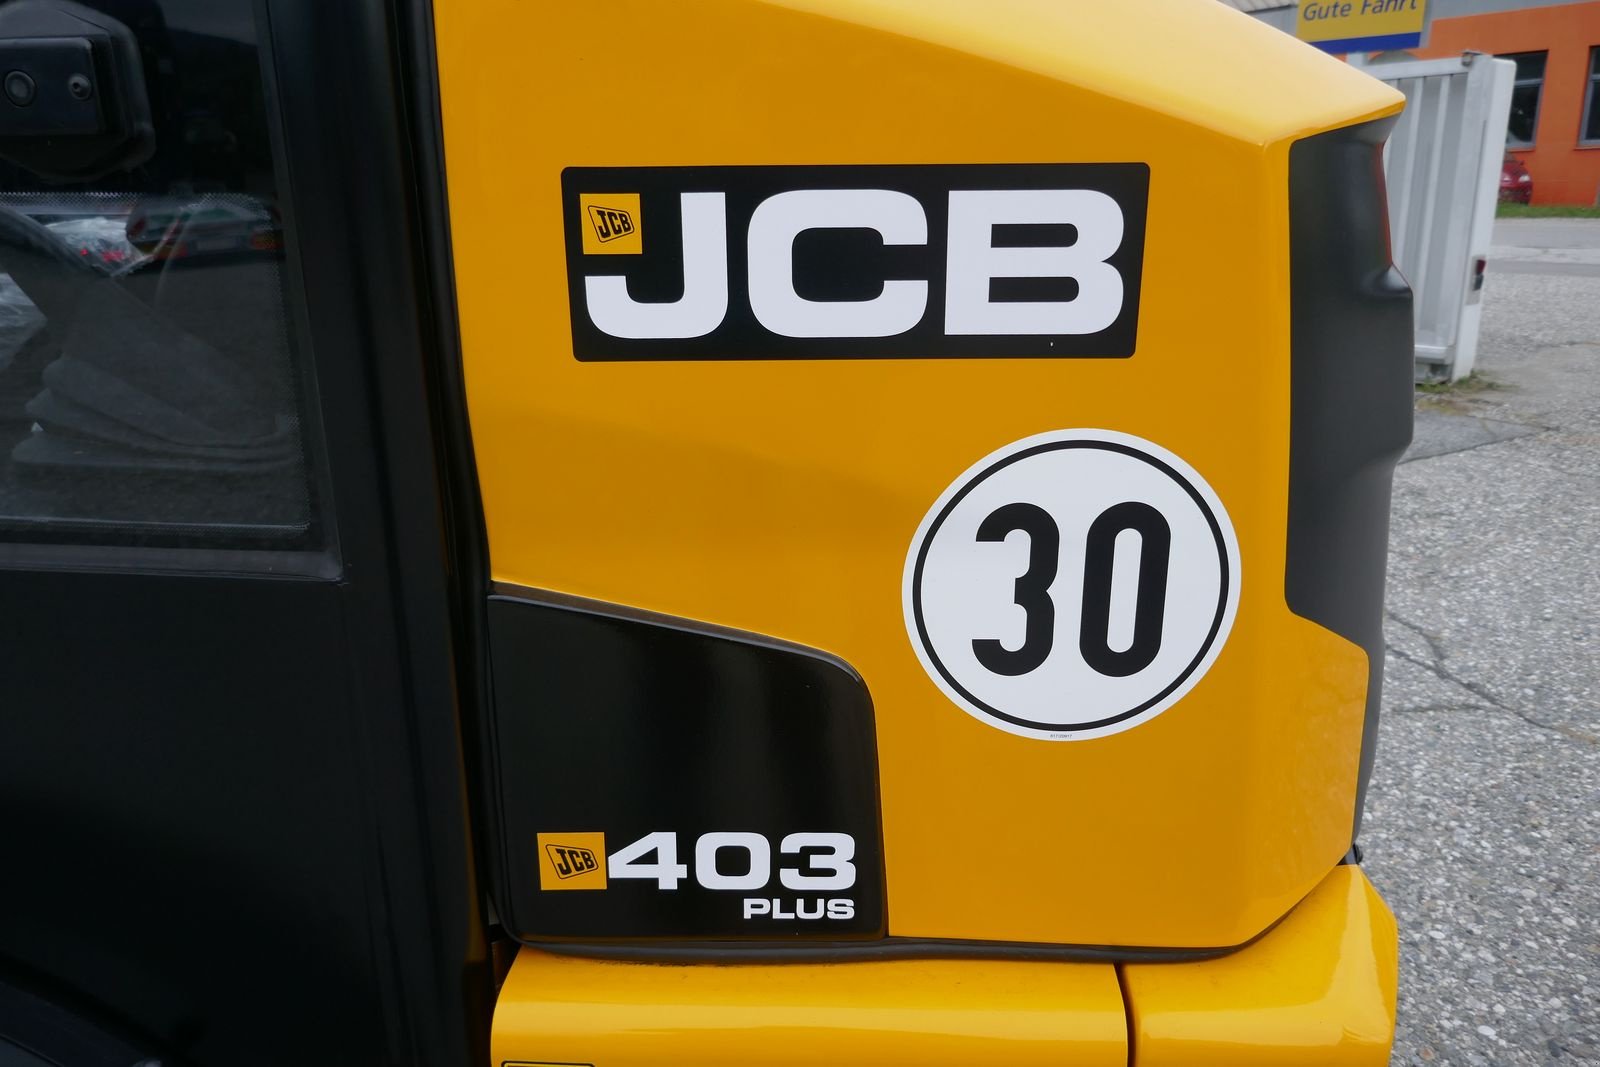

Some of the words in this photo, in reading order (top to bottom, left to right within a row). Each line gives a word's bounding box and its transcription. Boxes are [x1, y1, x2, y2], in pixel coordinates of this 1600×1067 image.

[1303, 2, 1352, 21] Gute
[596, 210, 632, 239] JCB
[585, 189, 1124, 339] JCB
[971, 501, 1171, 678] 30
[555, 848, 596, 876] JCB
[608, 832, 857, 890] 403
[743, 898, 855, 920] PLUS
